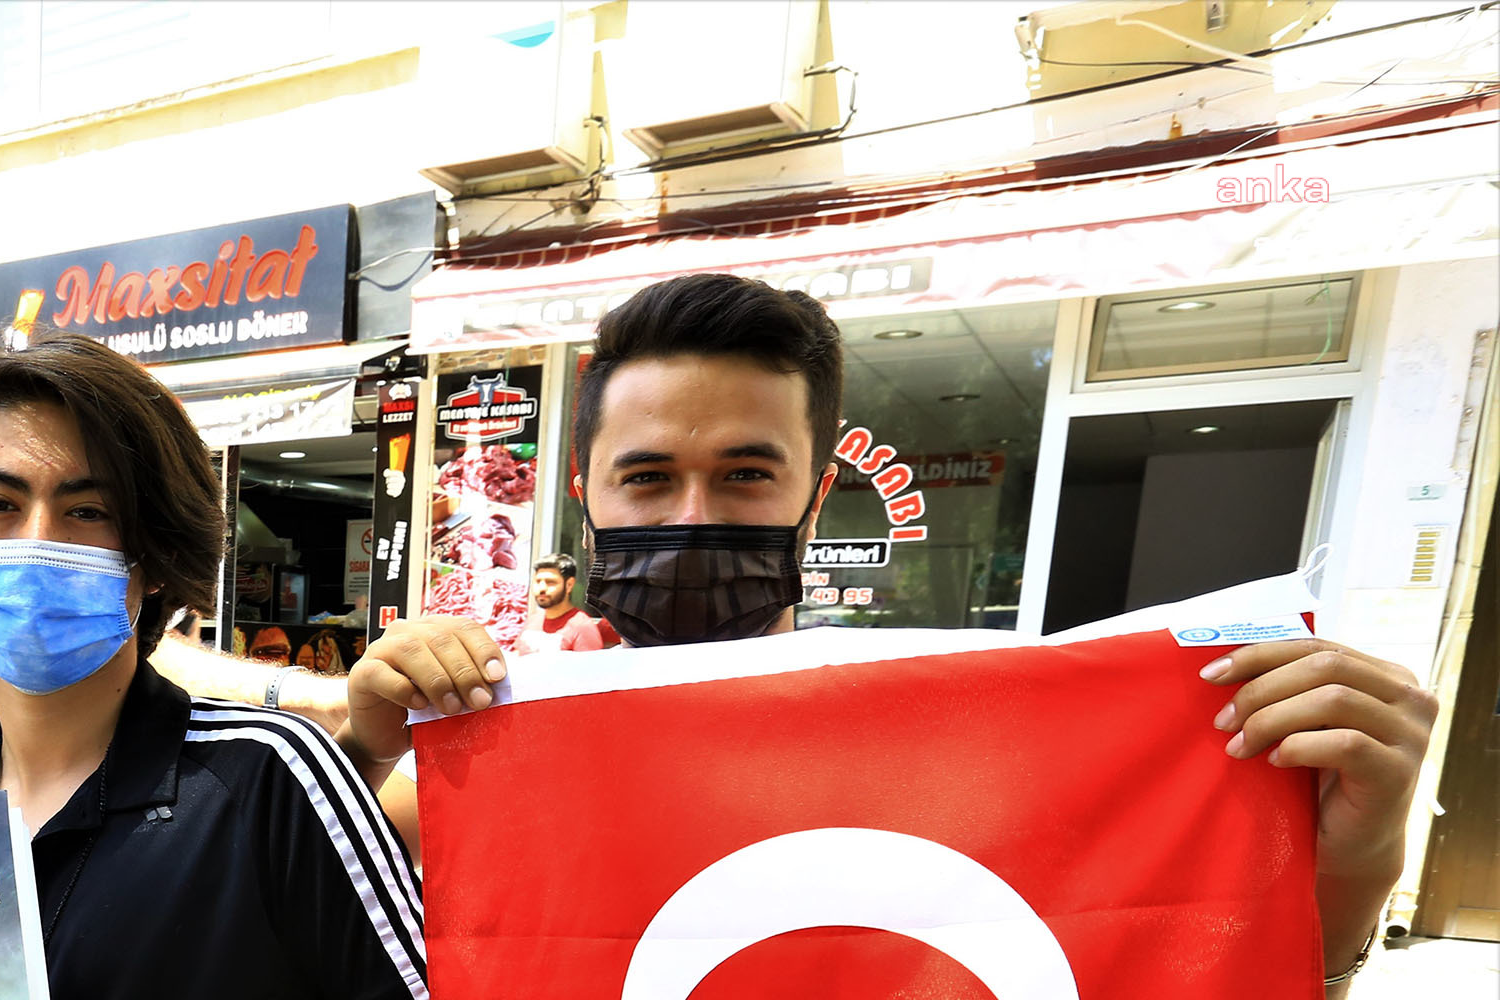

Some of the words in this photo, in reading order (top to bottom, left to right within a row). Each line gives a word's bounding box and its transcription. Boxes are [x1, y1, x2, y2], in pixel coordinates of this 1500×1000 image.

[52, 223, 319, 329] Maxsitat
[170, 320, 234, 350] SOSLU
[236, 310, 309, 342] DÖNER
[382, 412, 414, 423] LEZZET
[440, 406, 489, 421] MENTE
[490, 402, 533, 417] KASABI
[835, 420, 928, 543] ASABI
[1421, 485, 1431, 496] 5
[376, 537, 391, 561] EV
[387, 521, 408, 581] YAPIMI
[810, 587, 840, 606] 43
[843, 587, 874, 606] 95
